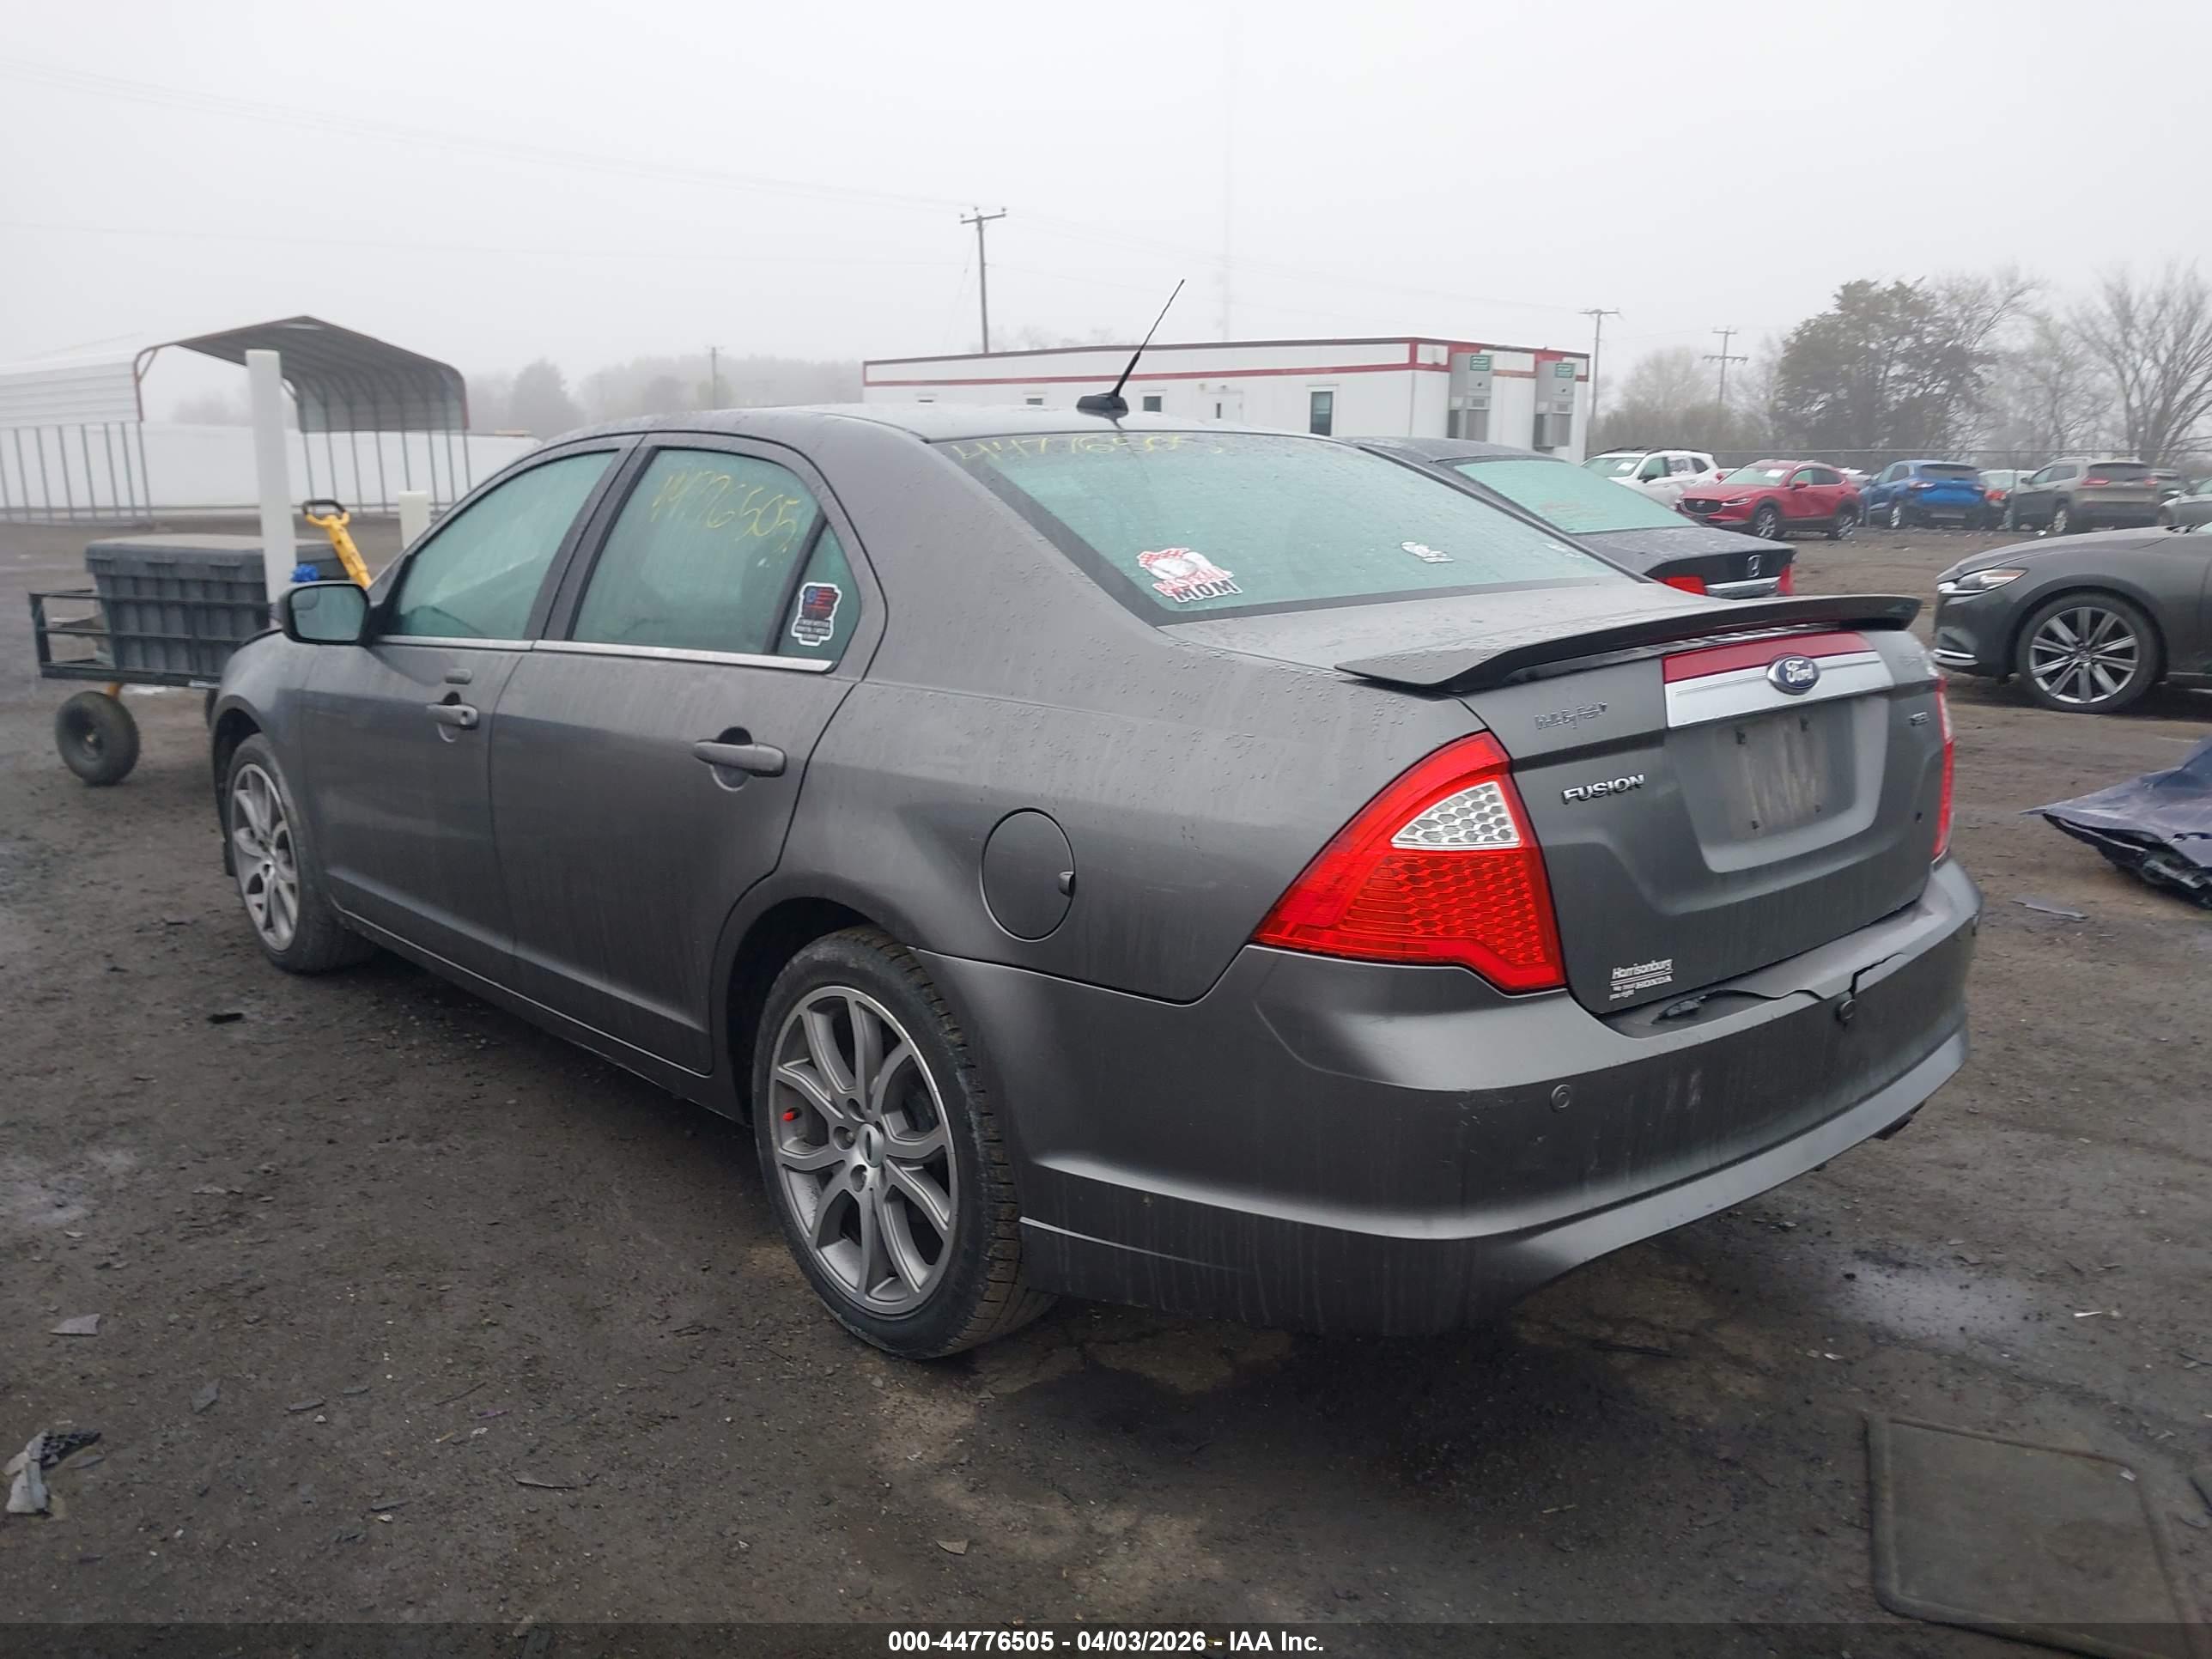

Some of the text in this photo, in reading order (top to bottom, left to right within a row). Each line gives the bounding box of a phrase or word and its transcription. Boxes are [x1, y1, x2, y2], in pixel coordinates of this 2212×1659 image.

[1172, 570, 1242, 602] MOM
[1784, 659, 1815, 684] Ford
[1562, 774, 1645, 804] FUSION
[1612, 958, 1674, 980] Harrisonburg
